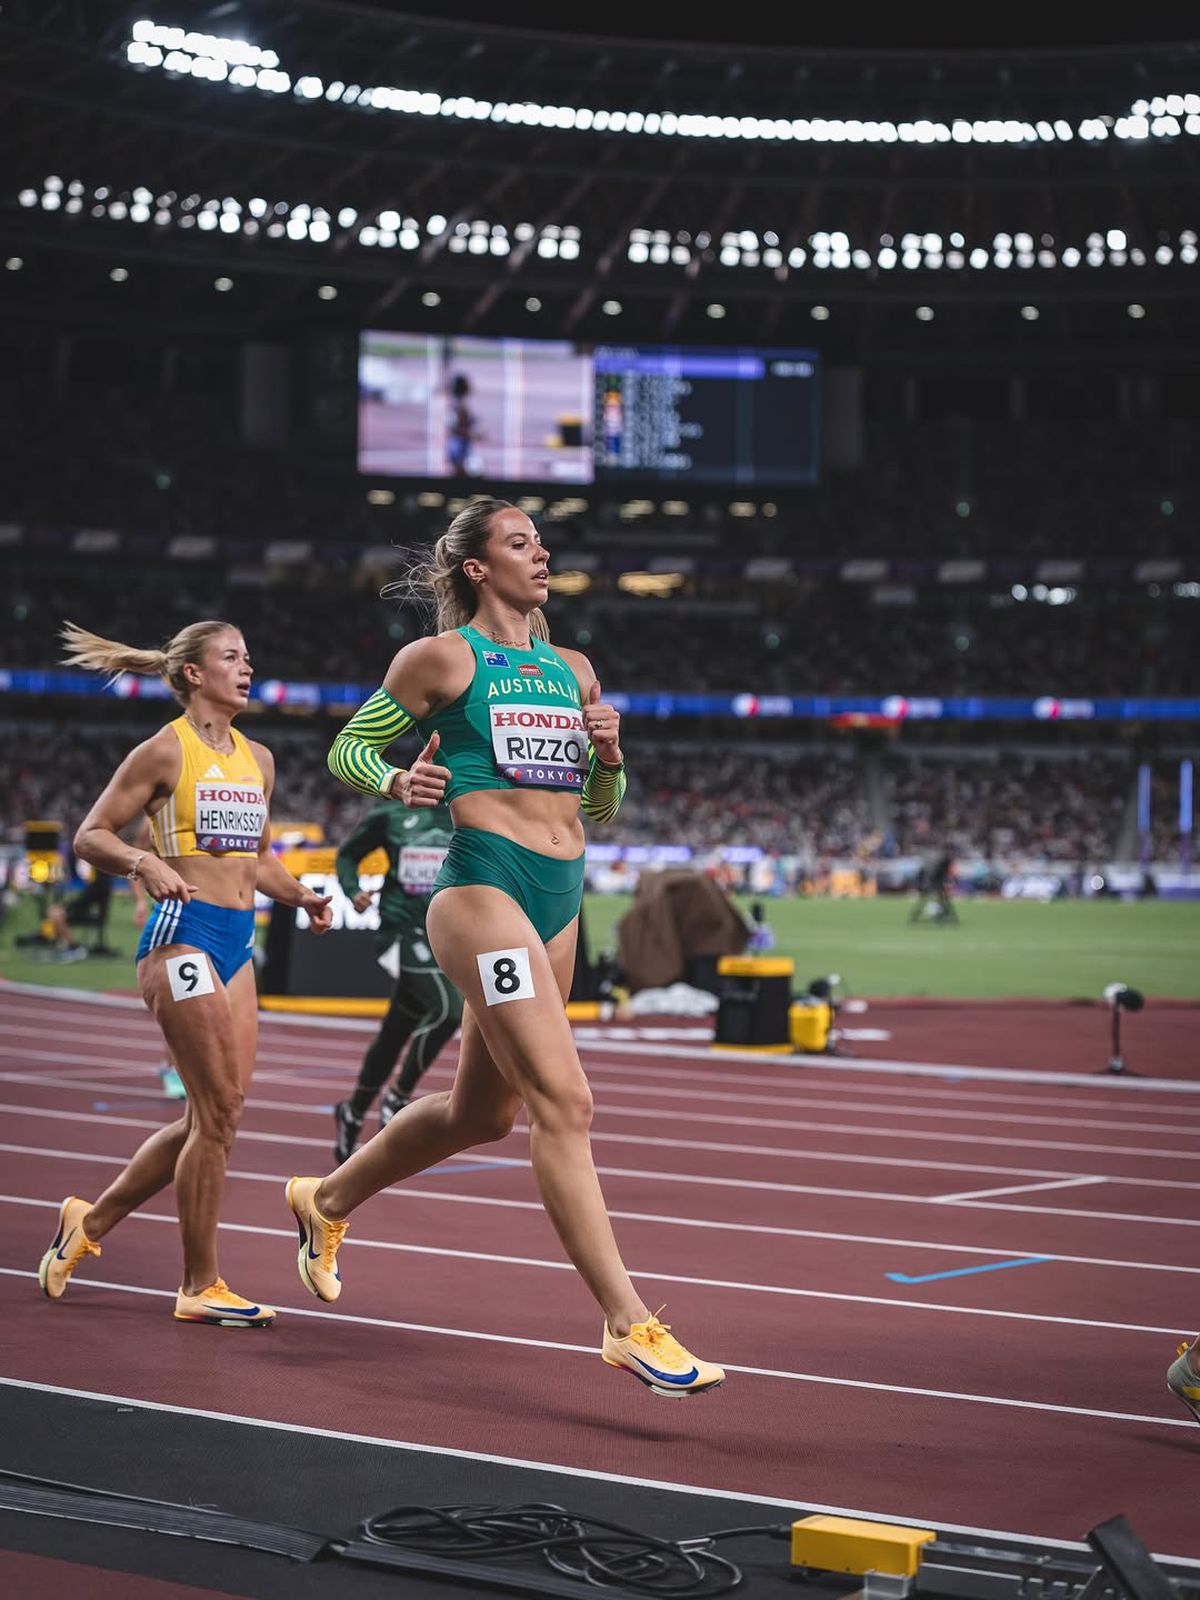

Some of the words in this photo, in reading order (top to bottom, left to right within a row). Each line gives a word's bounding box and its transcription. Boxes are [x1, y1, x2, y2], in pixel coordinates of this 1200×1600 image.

[493, 712, 585, 731] HONDA
[506, 736, 581, 764] RIZZO
[178, 961, 198, 992] 9
[493, 957, 520, 994] 8
